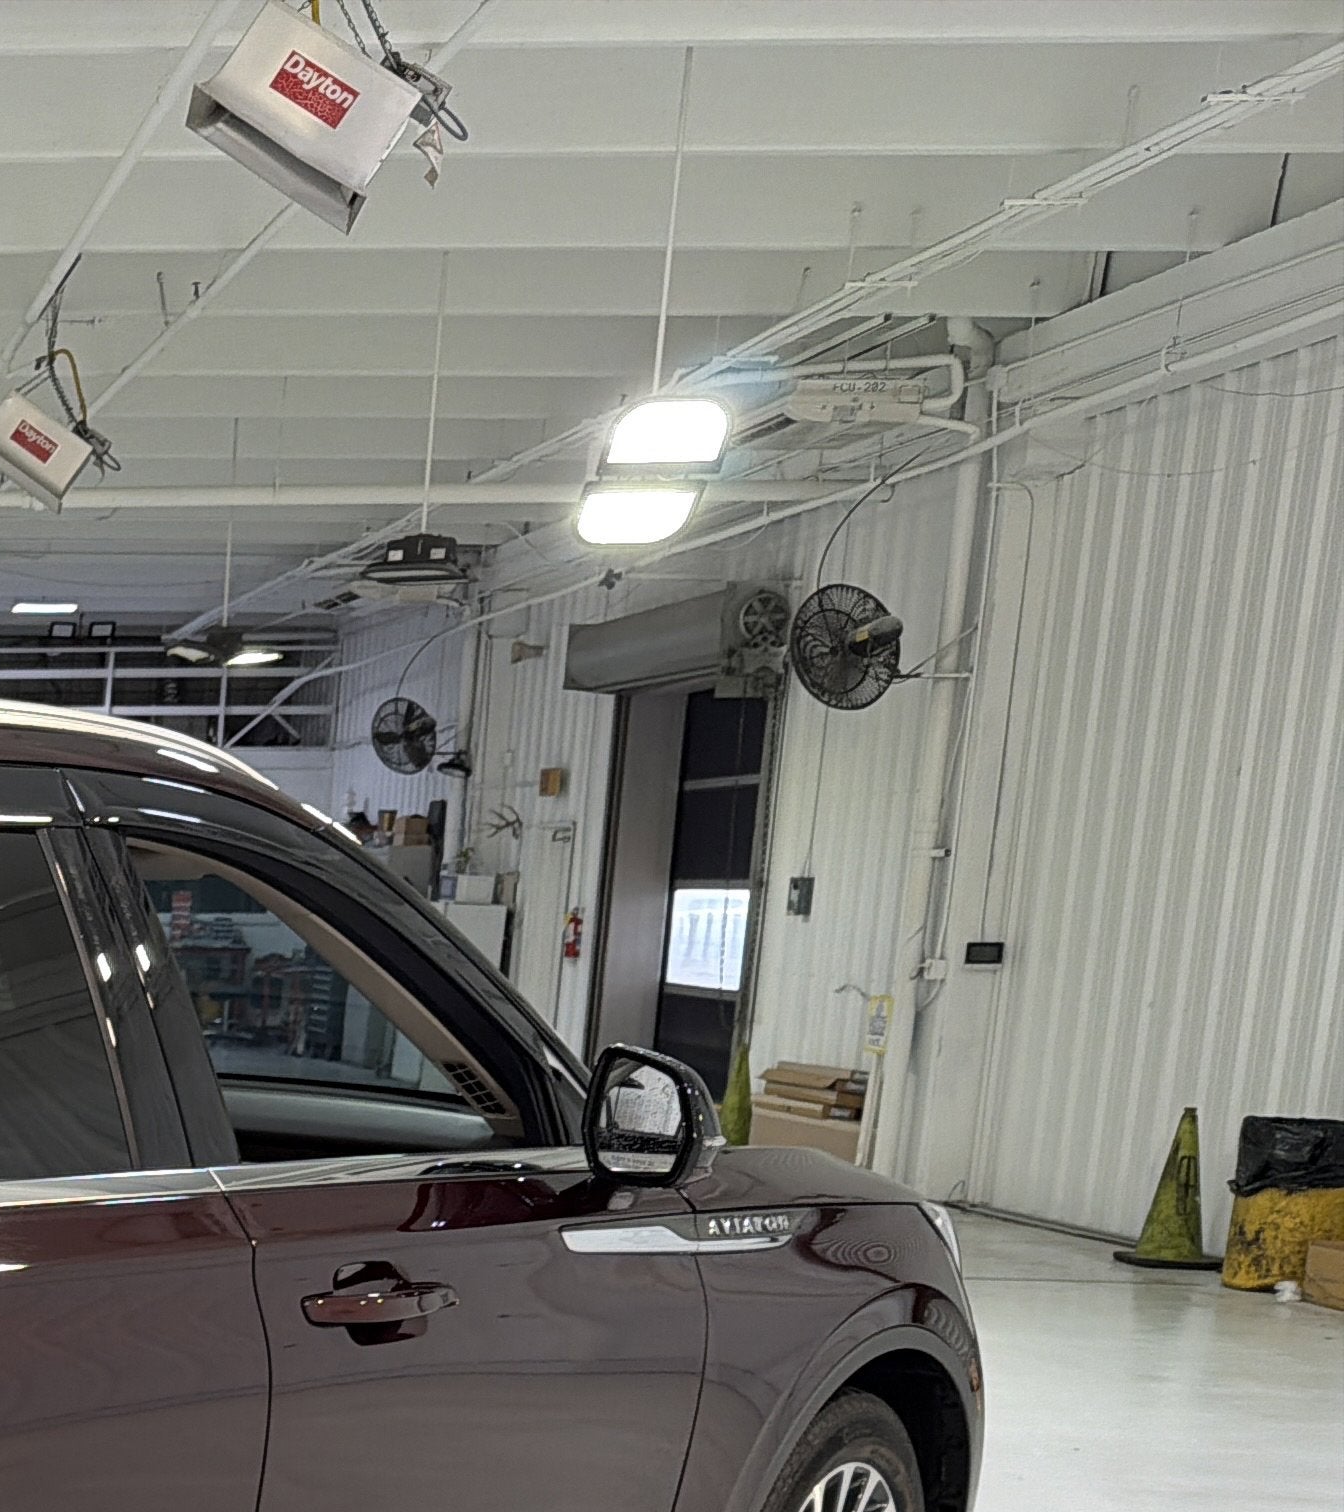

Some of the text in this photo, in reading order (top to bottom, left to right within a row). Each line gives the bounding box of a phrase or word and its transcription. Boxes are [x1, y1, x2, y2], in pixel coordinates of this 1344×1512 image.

[283, 54, 354, 109] Dayton
[18, 422, 56, 453] Dayton
[708, 1214, 789, 1236] AVIATOR
